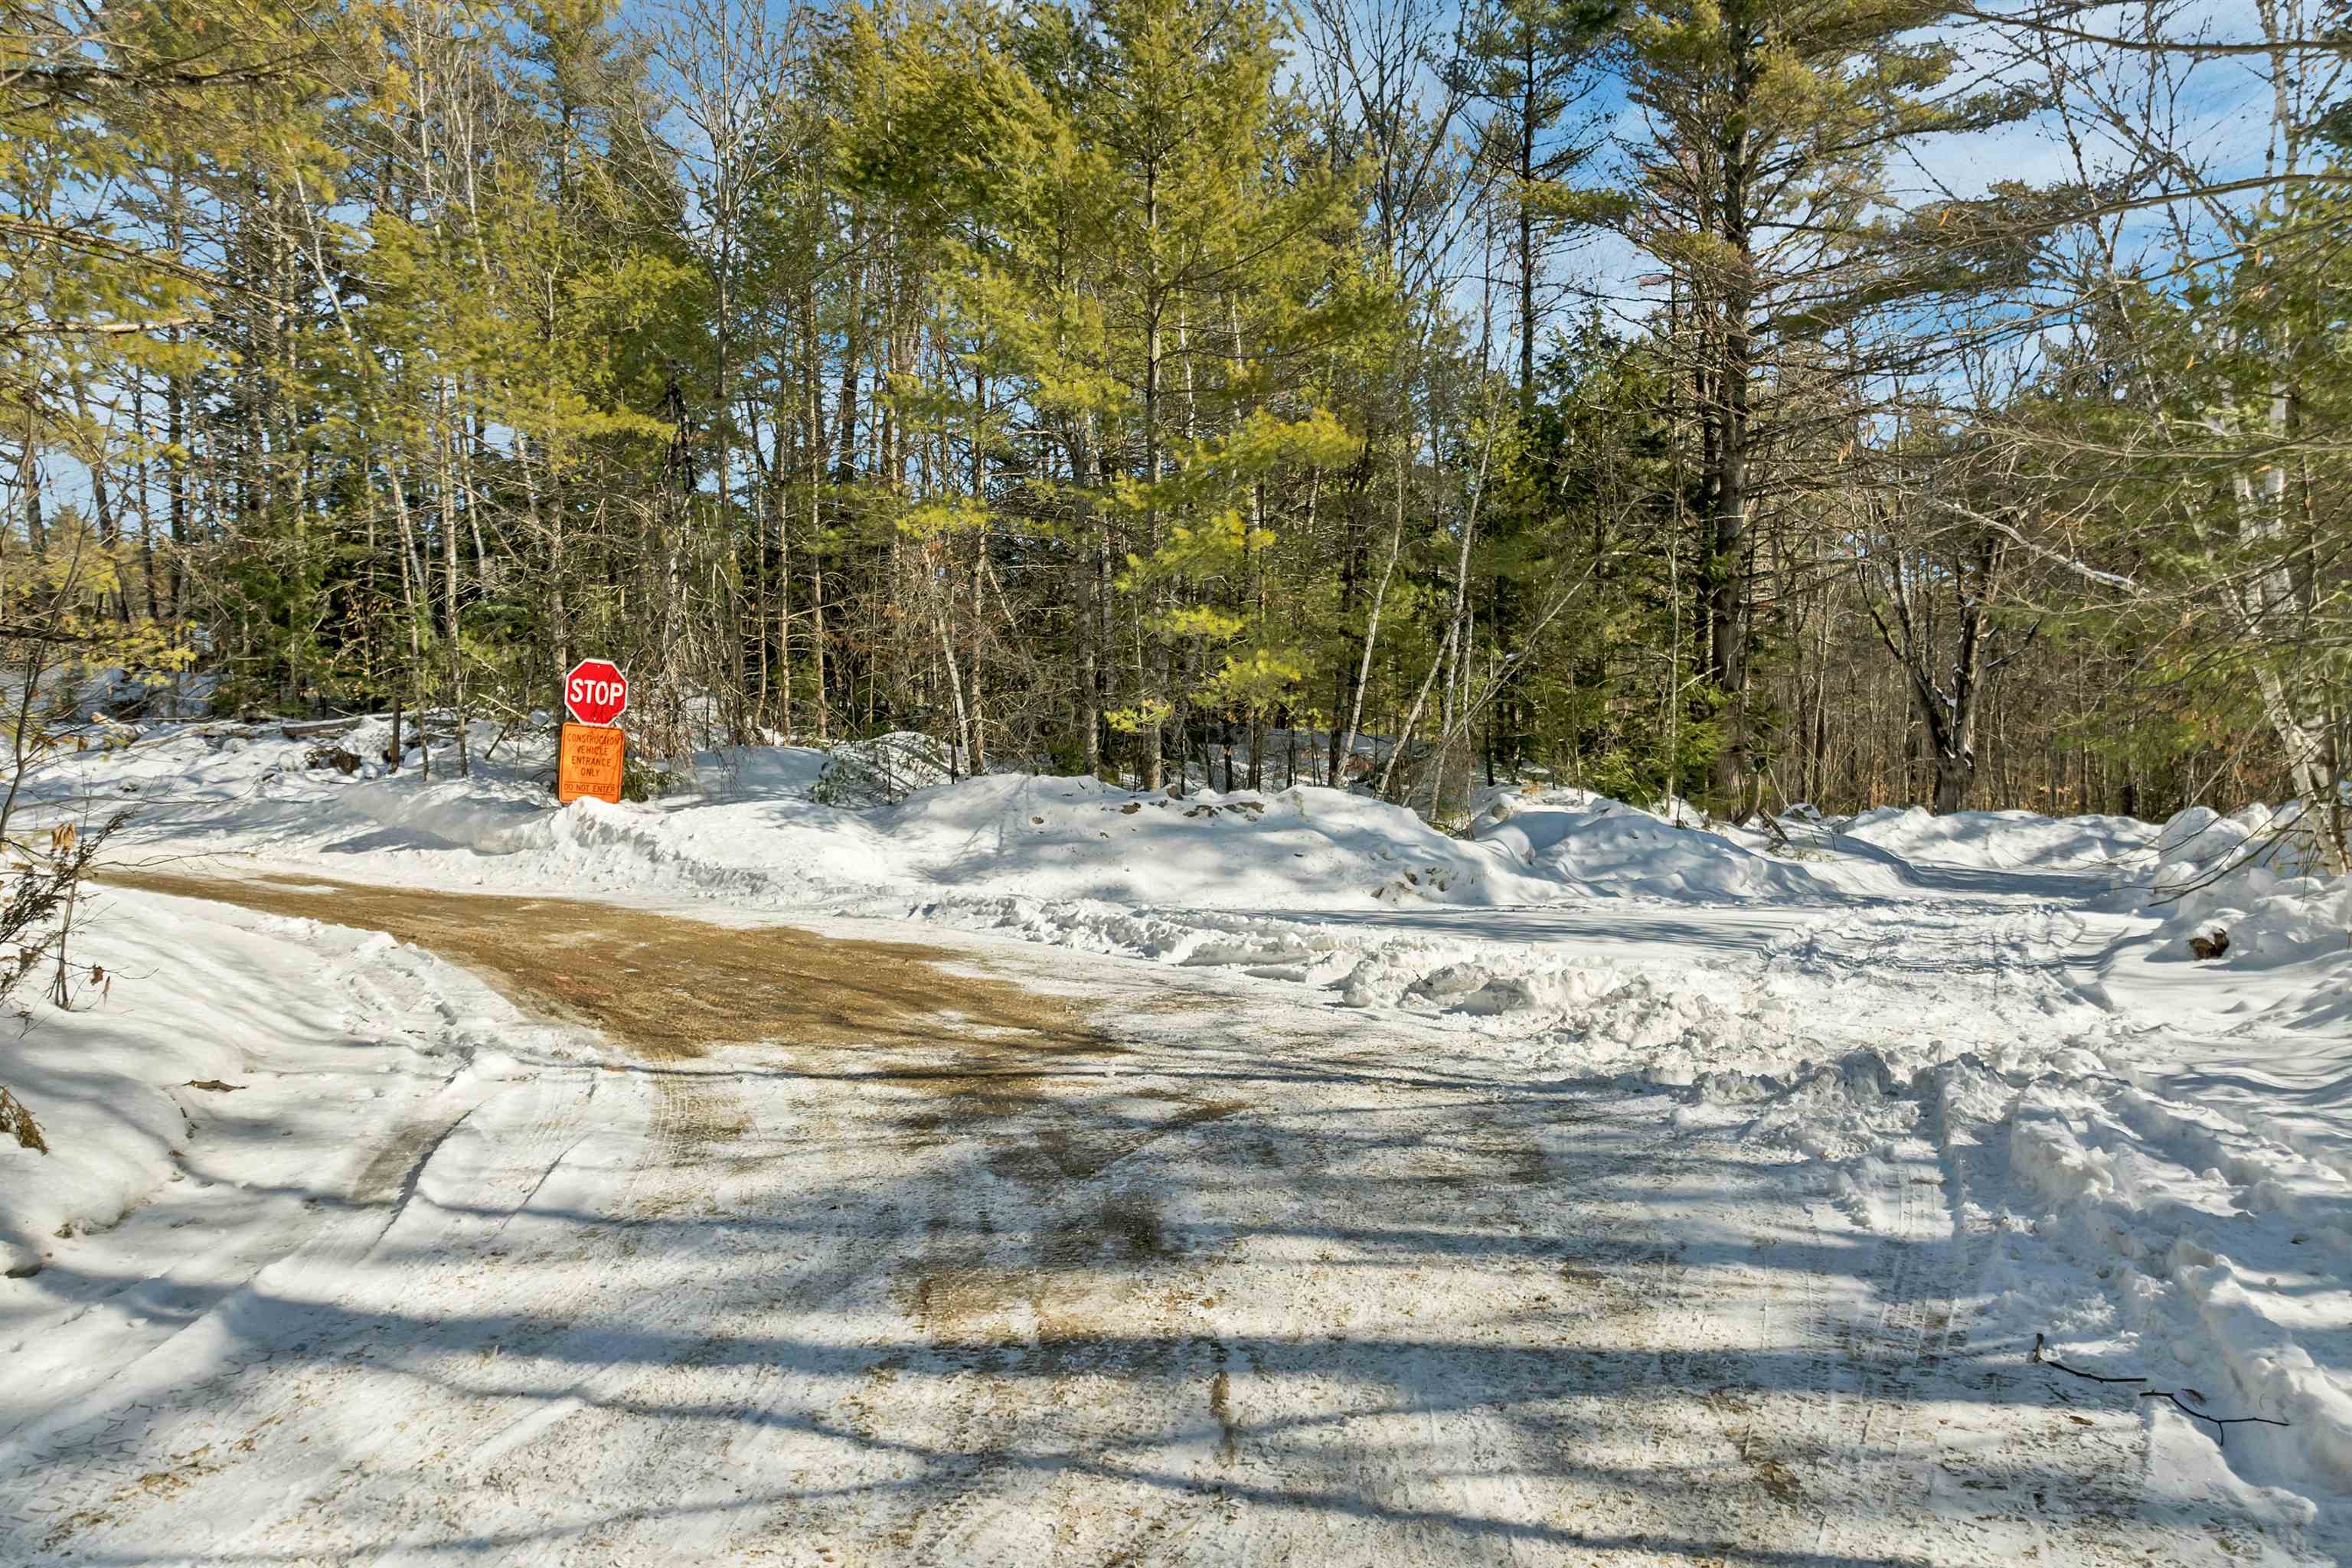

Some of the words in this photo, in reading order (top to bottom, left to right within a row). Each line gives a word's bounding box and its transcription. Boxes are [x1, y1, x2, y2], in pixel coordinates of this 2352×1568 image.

[570, 678, 624, 706] STOP
[567, 733, 619, 746] CONSTRUCTION
[577, 746, 608, 756] VEHICLE
[571, 756, 612, 766] ENTRANCE
[580, 767, 601, 777] ONLY
[593, 785, 616, 793] ENTER
